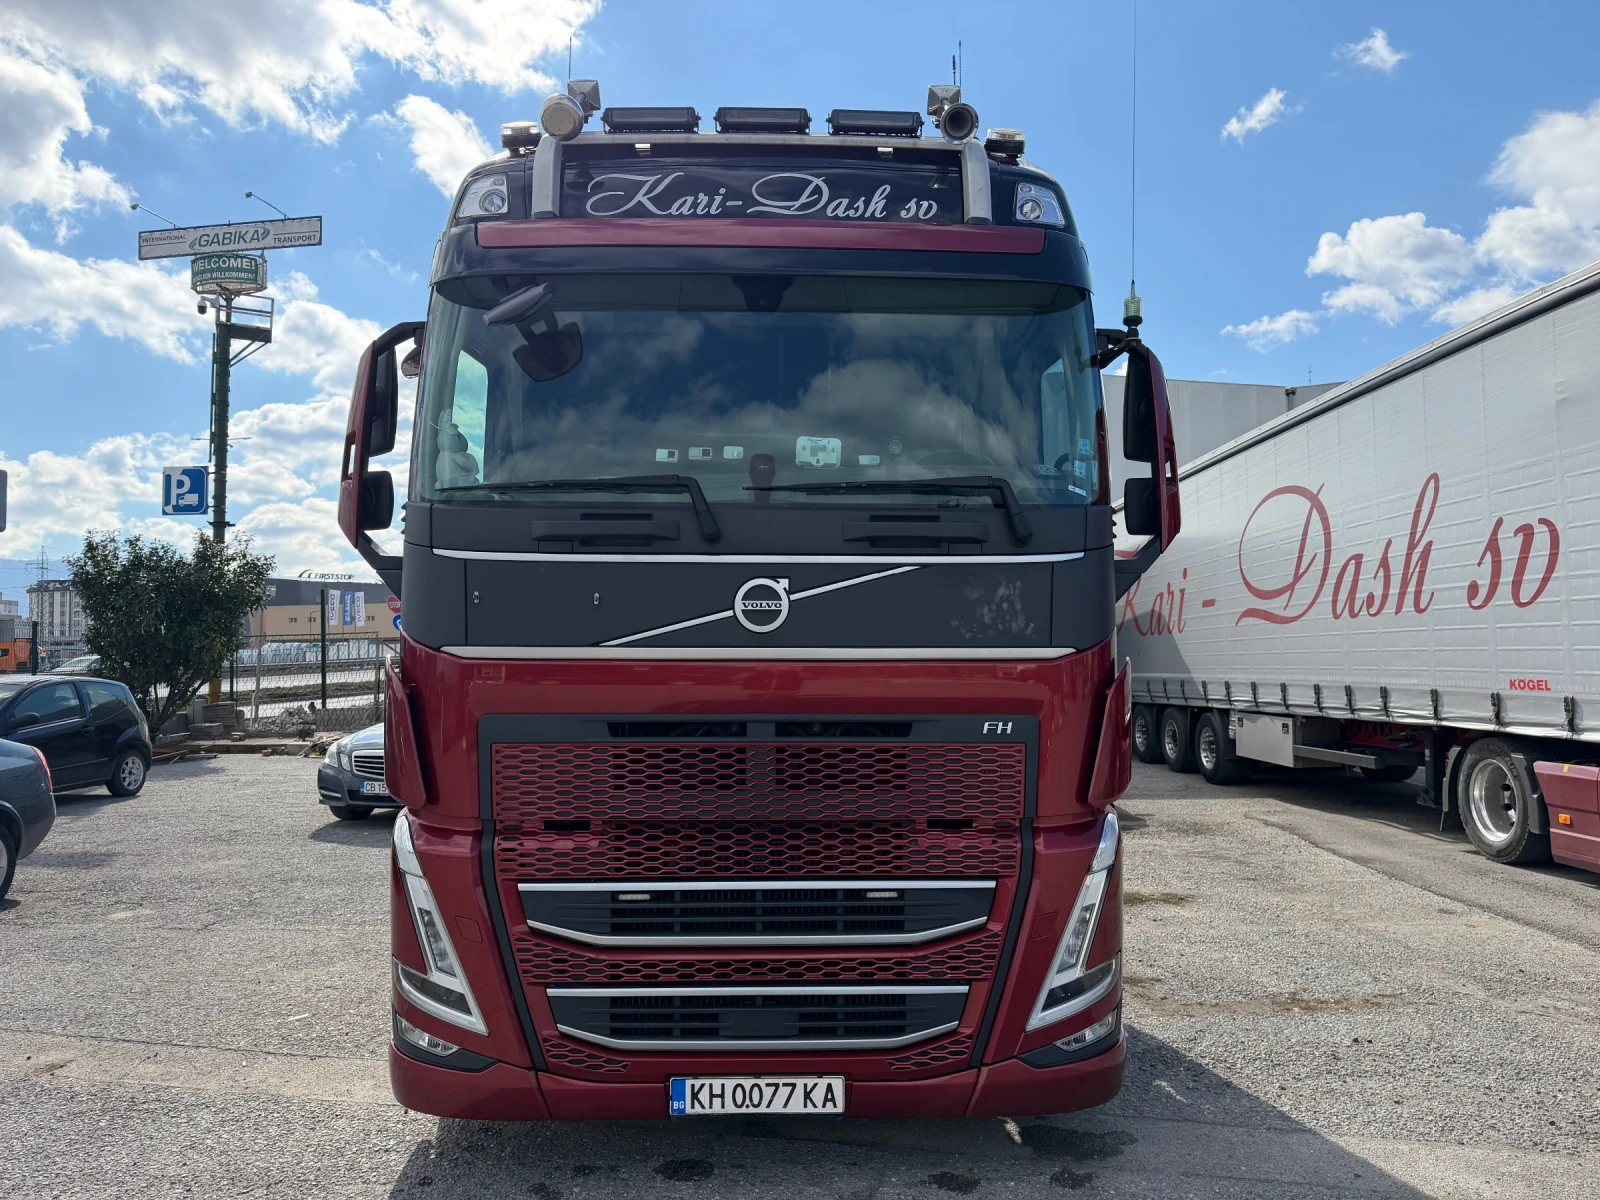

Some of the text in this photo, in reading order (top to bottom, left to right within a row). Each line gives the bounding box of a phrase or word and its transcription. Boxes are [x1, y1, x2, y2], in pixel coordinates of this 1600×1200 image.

[142, 234, 187, 244] INTERNATIONAL
[197, 229, 261, 248] GABIKA
[273, 234, 317, 244] TRANSPORT
[192, 257, 256, 273] WELCOME!
[170, 473, 191, 506] P
[1235, 472, 1440, 626] Dash
[1509, 678, 1552, 691] KÖGEL
[982, 721, 1013, 734] FH
[365, 782, 375, 792] CB
[673, 1101, 685, 1109] BG
